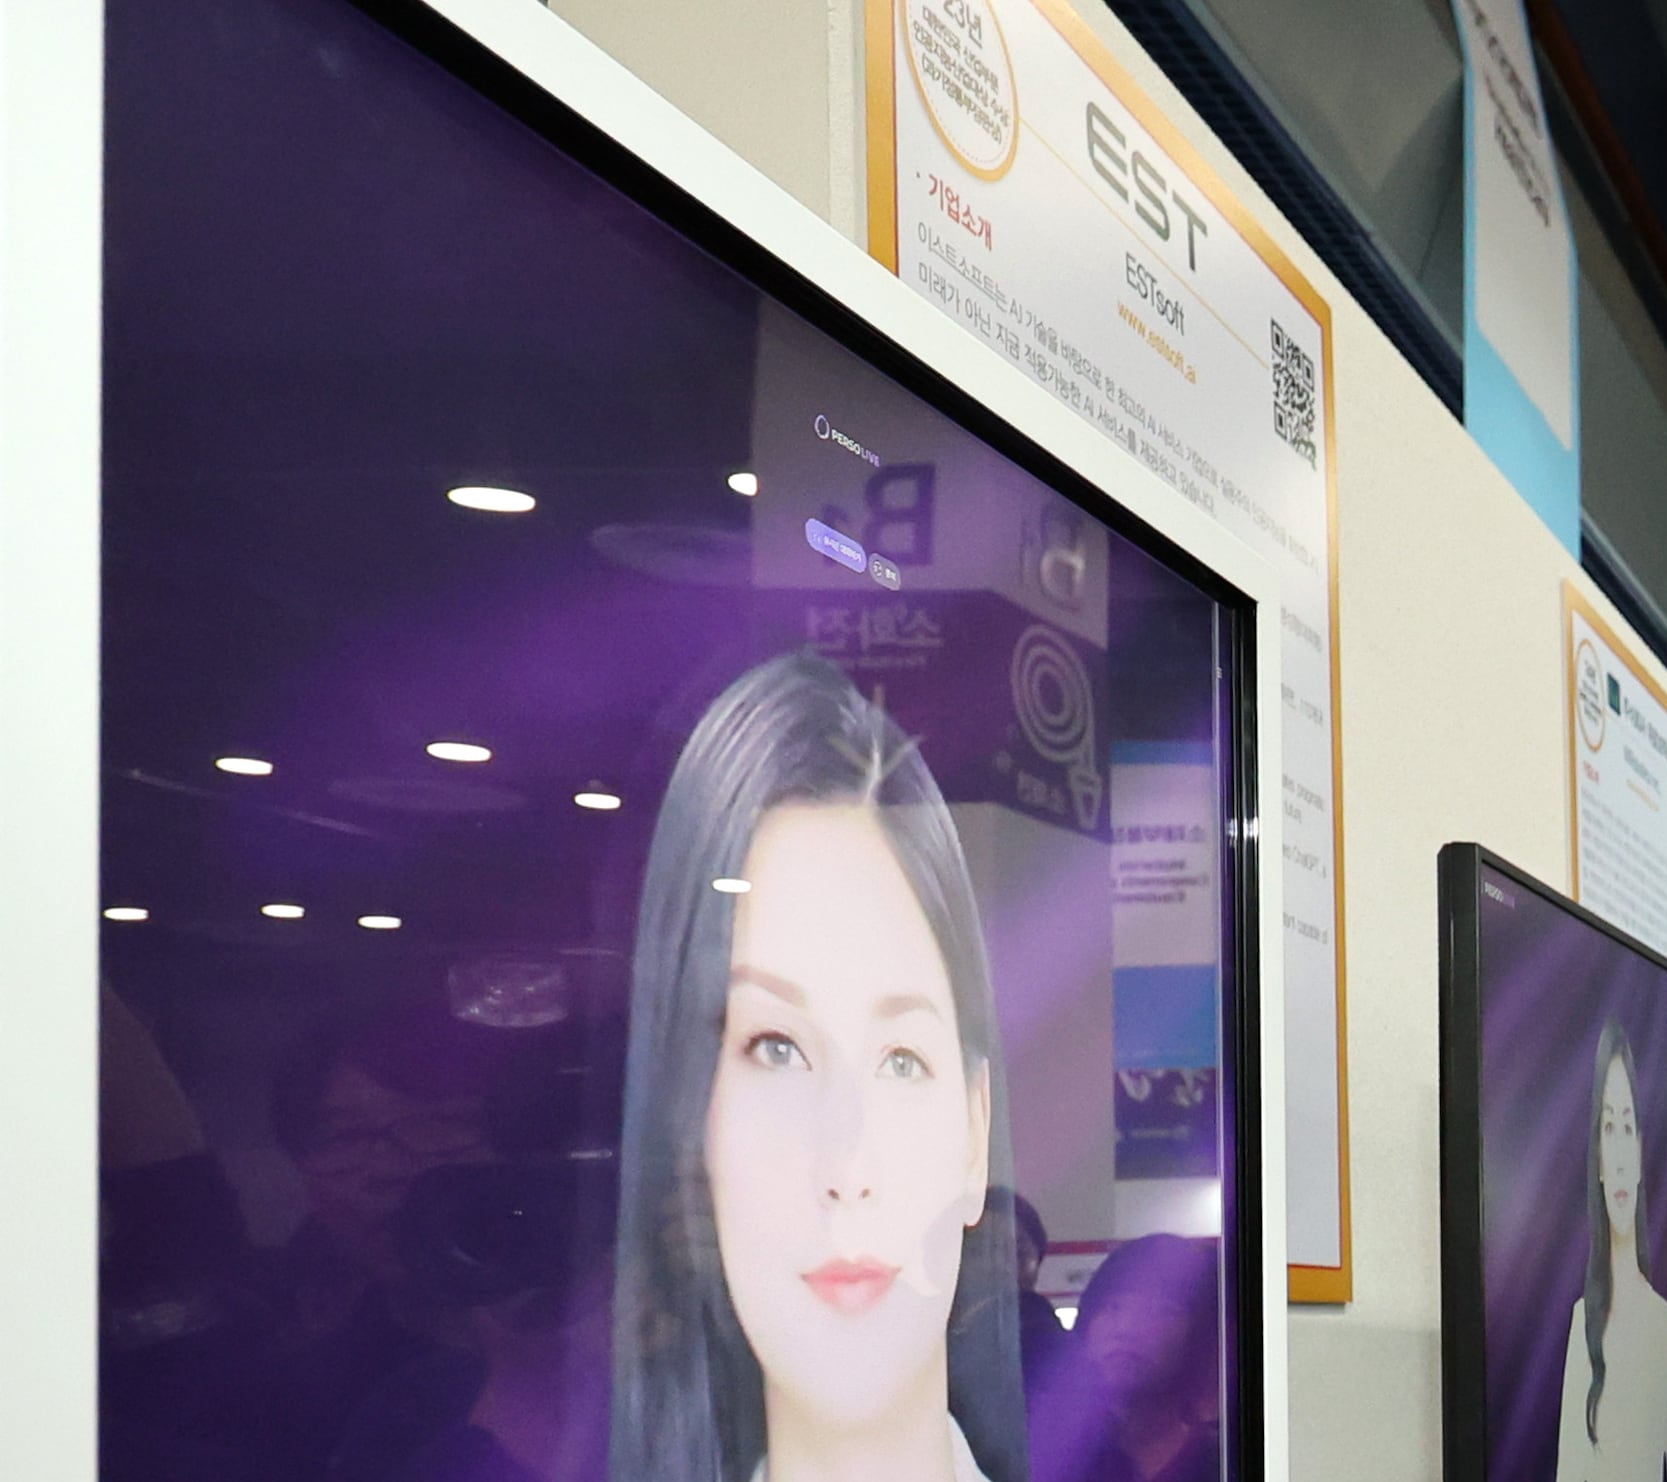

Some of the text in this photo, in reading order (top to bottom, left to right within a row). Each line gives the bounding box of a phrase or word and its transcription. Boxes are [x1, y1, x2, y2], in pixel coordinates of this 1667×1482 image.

[928, 173, 992, 251] 기업소개
[1086, 101, 1208, 272] EST
[918, 221, 1007, 313] 이스트소프트는
[918, 261, 960, 315] 미래가
[965, 297, 991, 338] 아닌
[996, 322, 1020, 361] 지금
[1125, 251, 1186, 336] ESTsoft
[832, 429, 881, 468] PERSO LIVE
